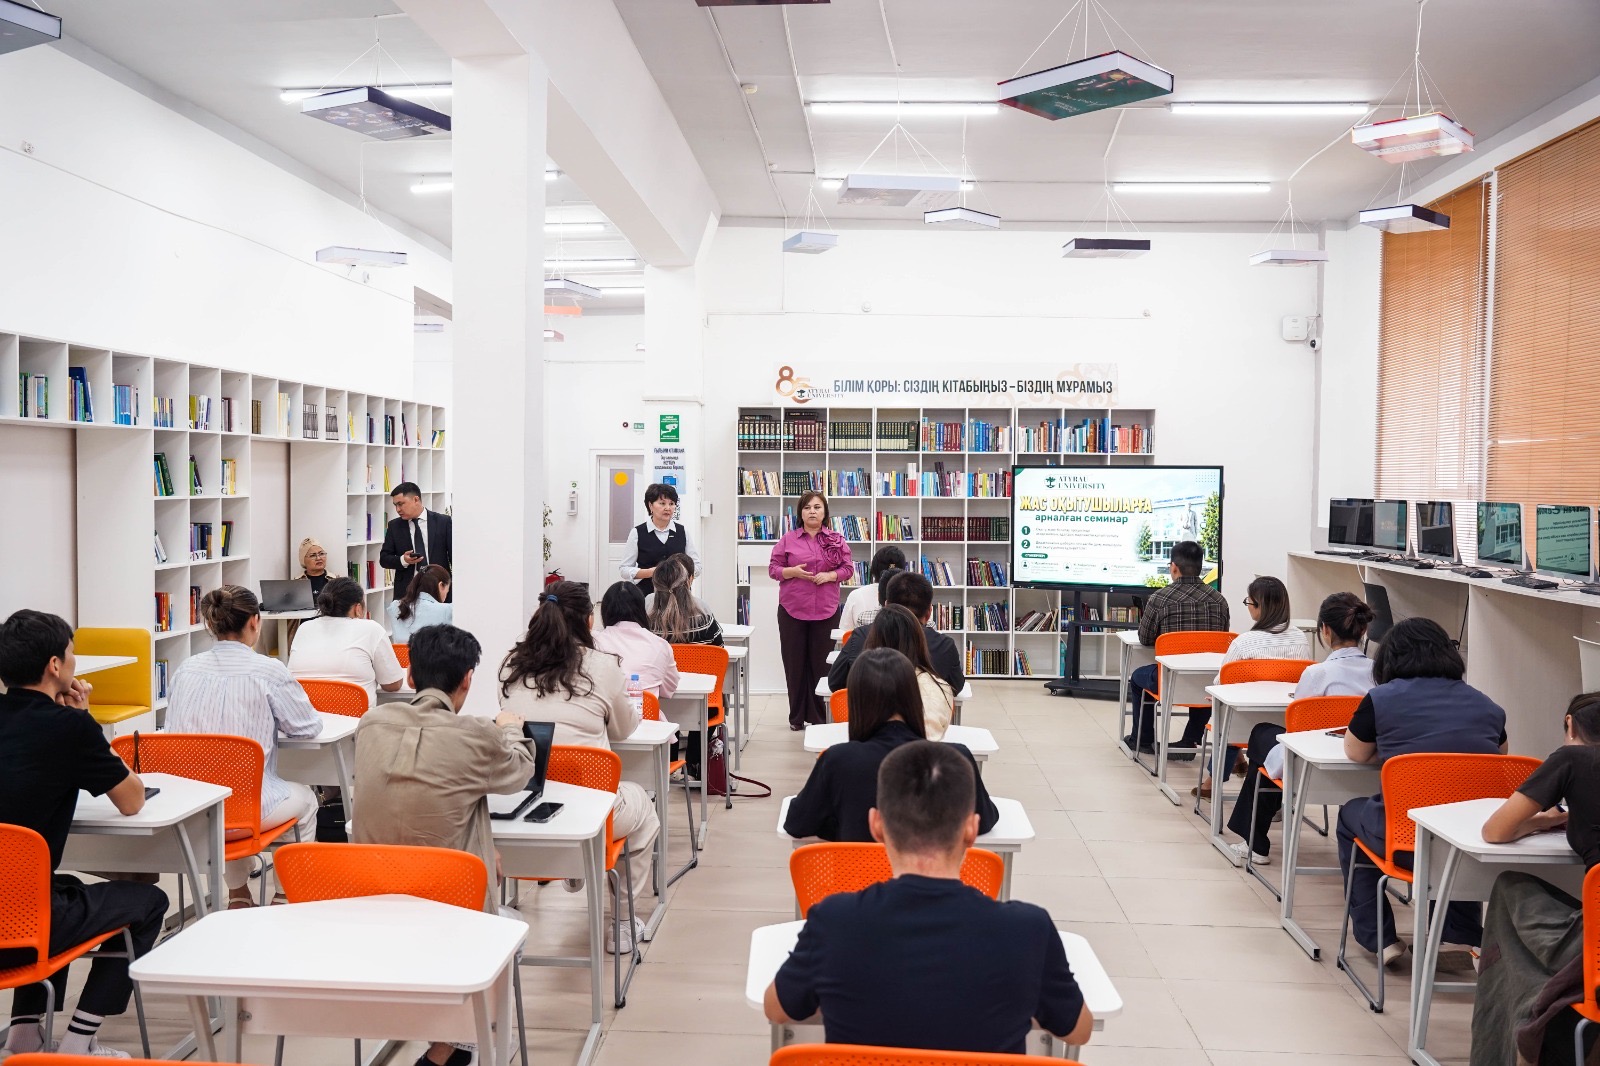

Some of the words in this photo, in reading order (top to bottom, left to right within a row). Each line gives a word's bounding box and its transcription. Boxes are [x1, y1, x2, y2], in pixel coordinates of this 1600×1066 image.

[834, 380, 864, 392] БІЛІМ
[867, 380, 900, 393] ҚОРЫ:
[903, 380, 939, 393] СІЗДІҢ
[943, 380, 1008, 394] КІТАБЫҢЫЗ
[1056, 380, 1113, 394] МҰРАМЫЗ
[1020, 496, 1047, 511] ЖАС
[1050, 496, 1152, 514] ОҚЫТУШЫЛАРҒА
[1035, 514, 1082, 523] арналған
[1084, 515, 1128, 525] семинар
